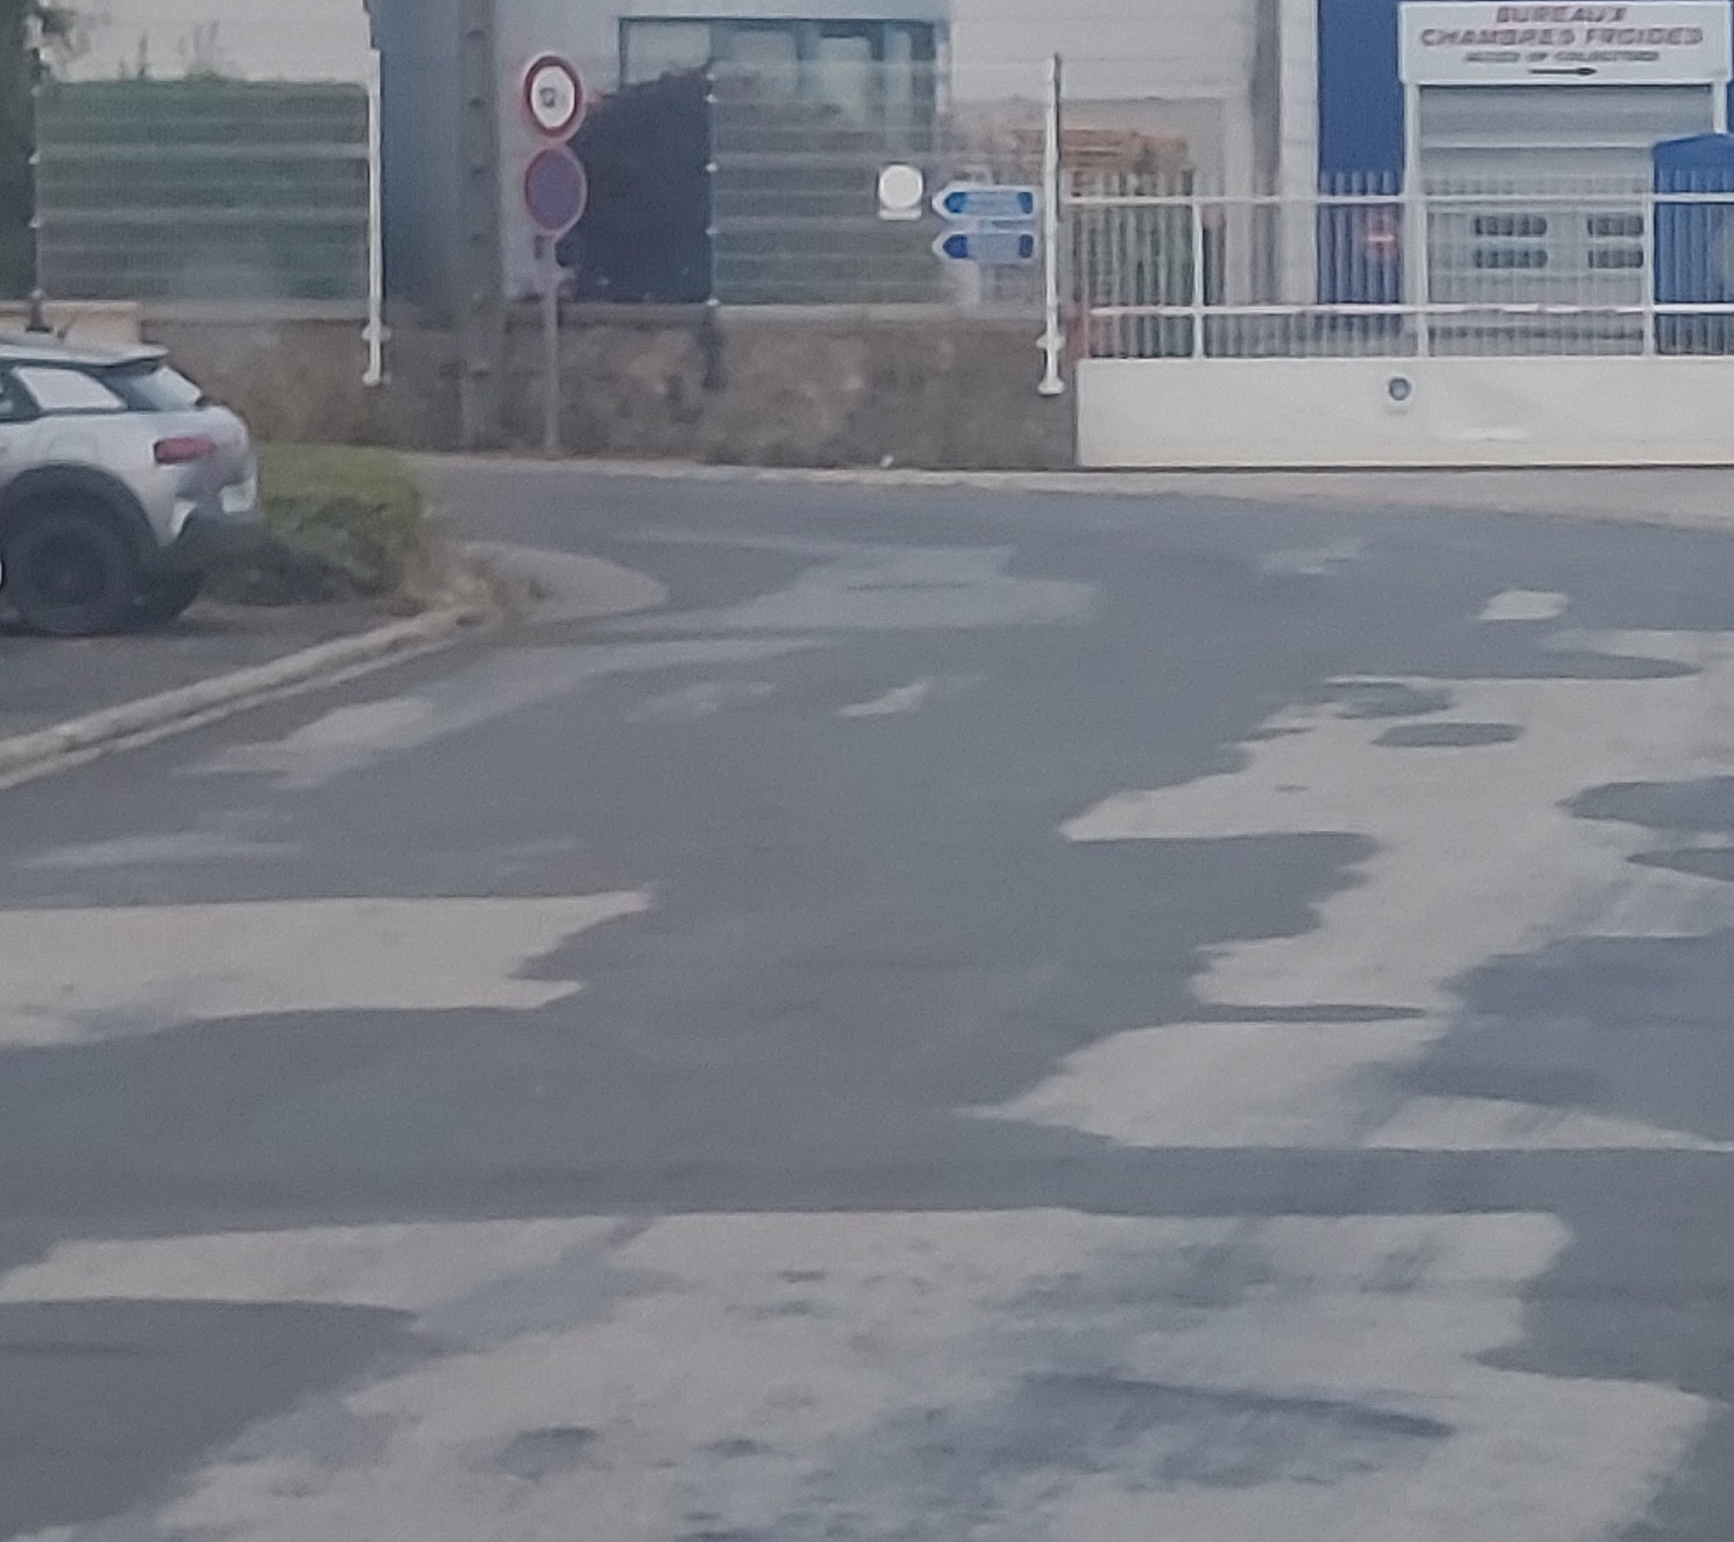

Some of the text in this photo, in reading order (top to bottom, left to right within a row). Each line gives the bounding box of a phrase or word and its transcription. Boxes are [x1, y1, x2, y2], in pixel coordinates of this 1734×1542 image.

[1497, 6, 1627, 23] BUREAUX
[1421, 27, 1704, 47] CHAMBRES FROIDES
